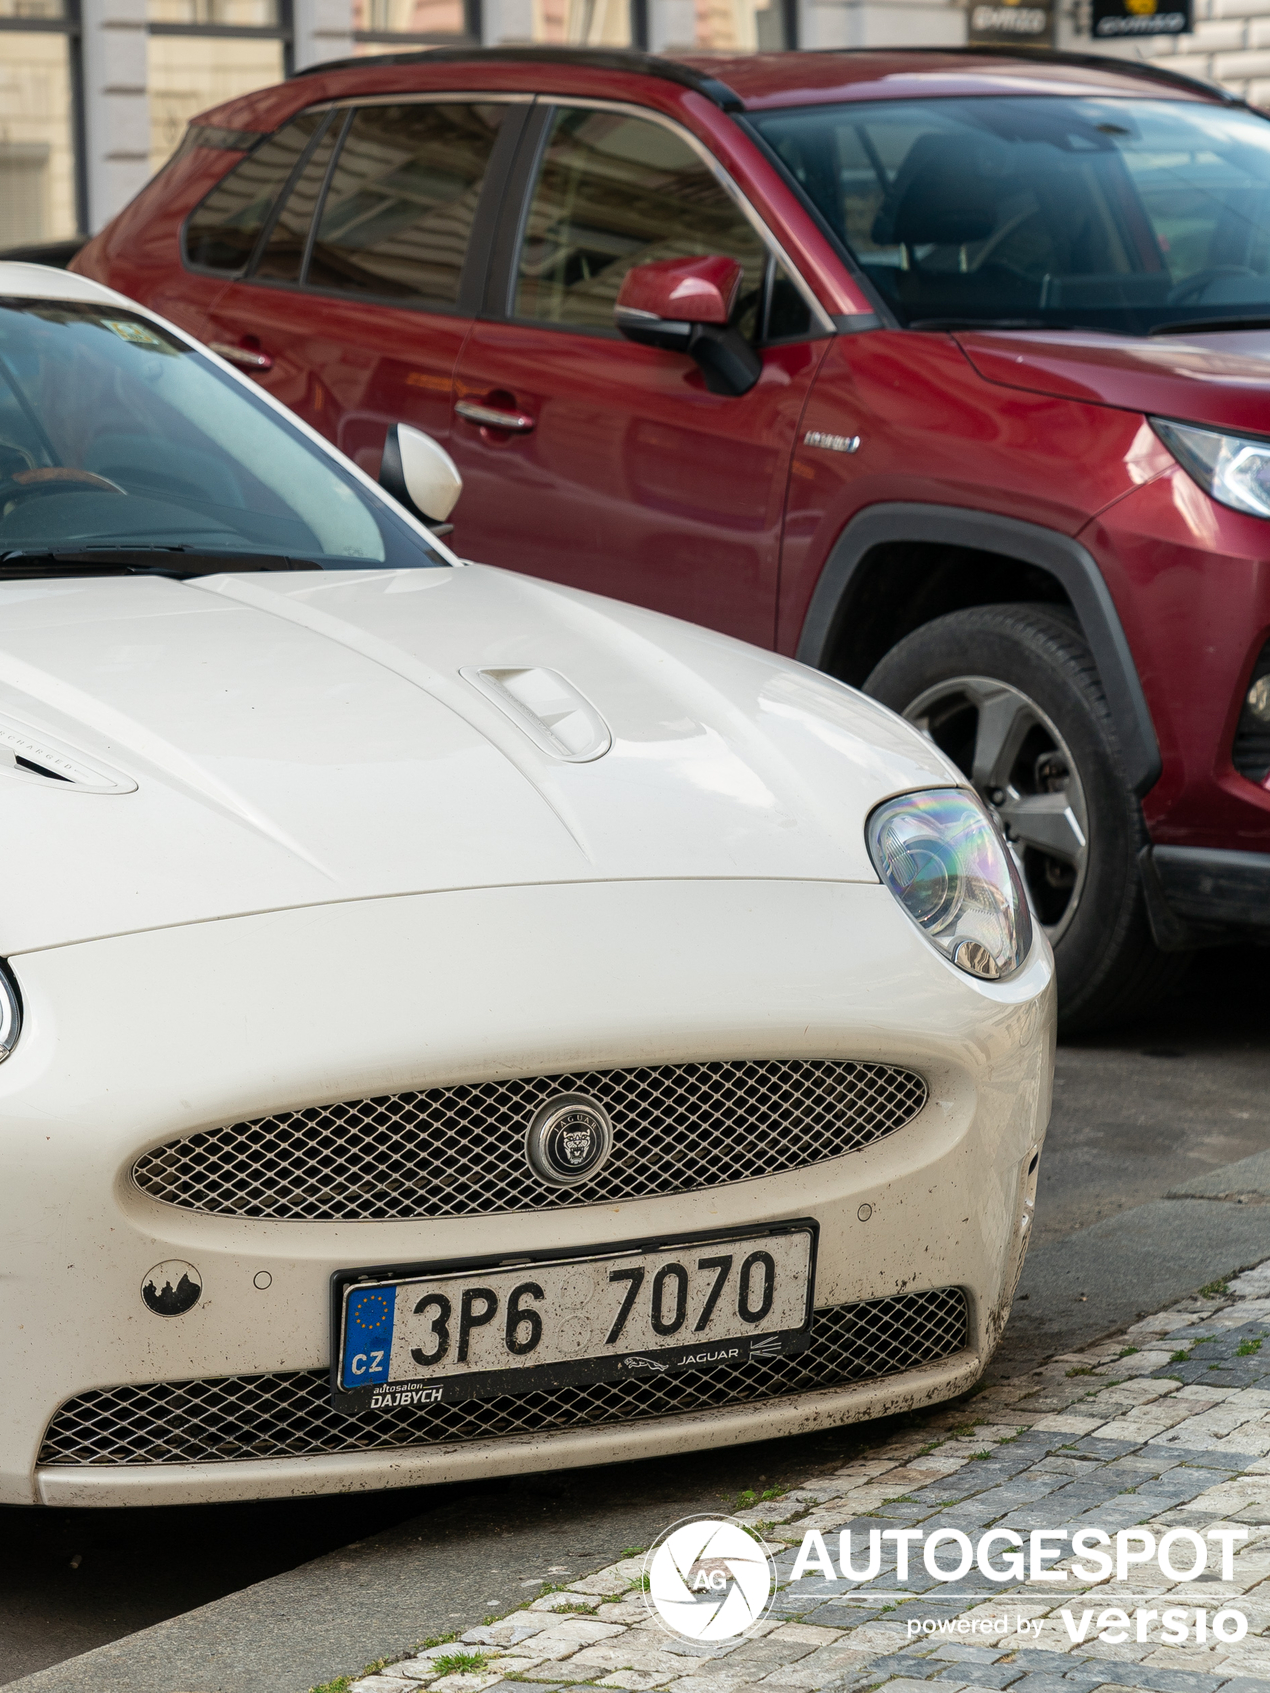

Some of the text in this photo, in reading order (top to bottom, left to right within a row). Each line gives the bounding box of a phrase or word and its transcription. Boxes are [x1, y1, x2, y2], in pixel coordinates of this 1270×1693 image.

[553, 1114, 597, 1133] JAGUAR
[410, 1250, 776, 1366] 3P6 7070
[351, 1350, 385, 1375] CZ
[677, 1348, 740, 1366] JAGUAR
[373, 1382, 424, 1394] autosalon
[370, 1388, 444, 1409] DAJBYCH
